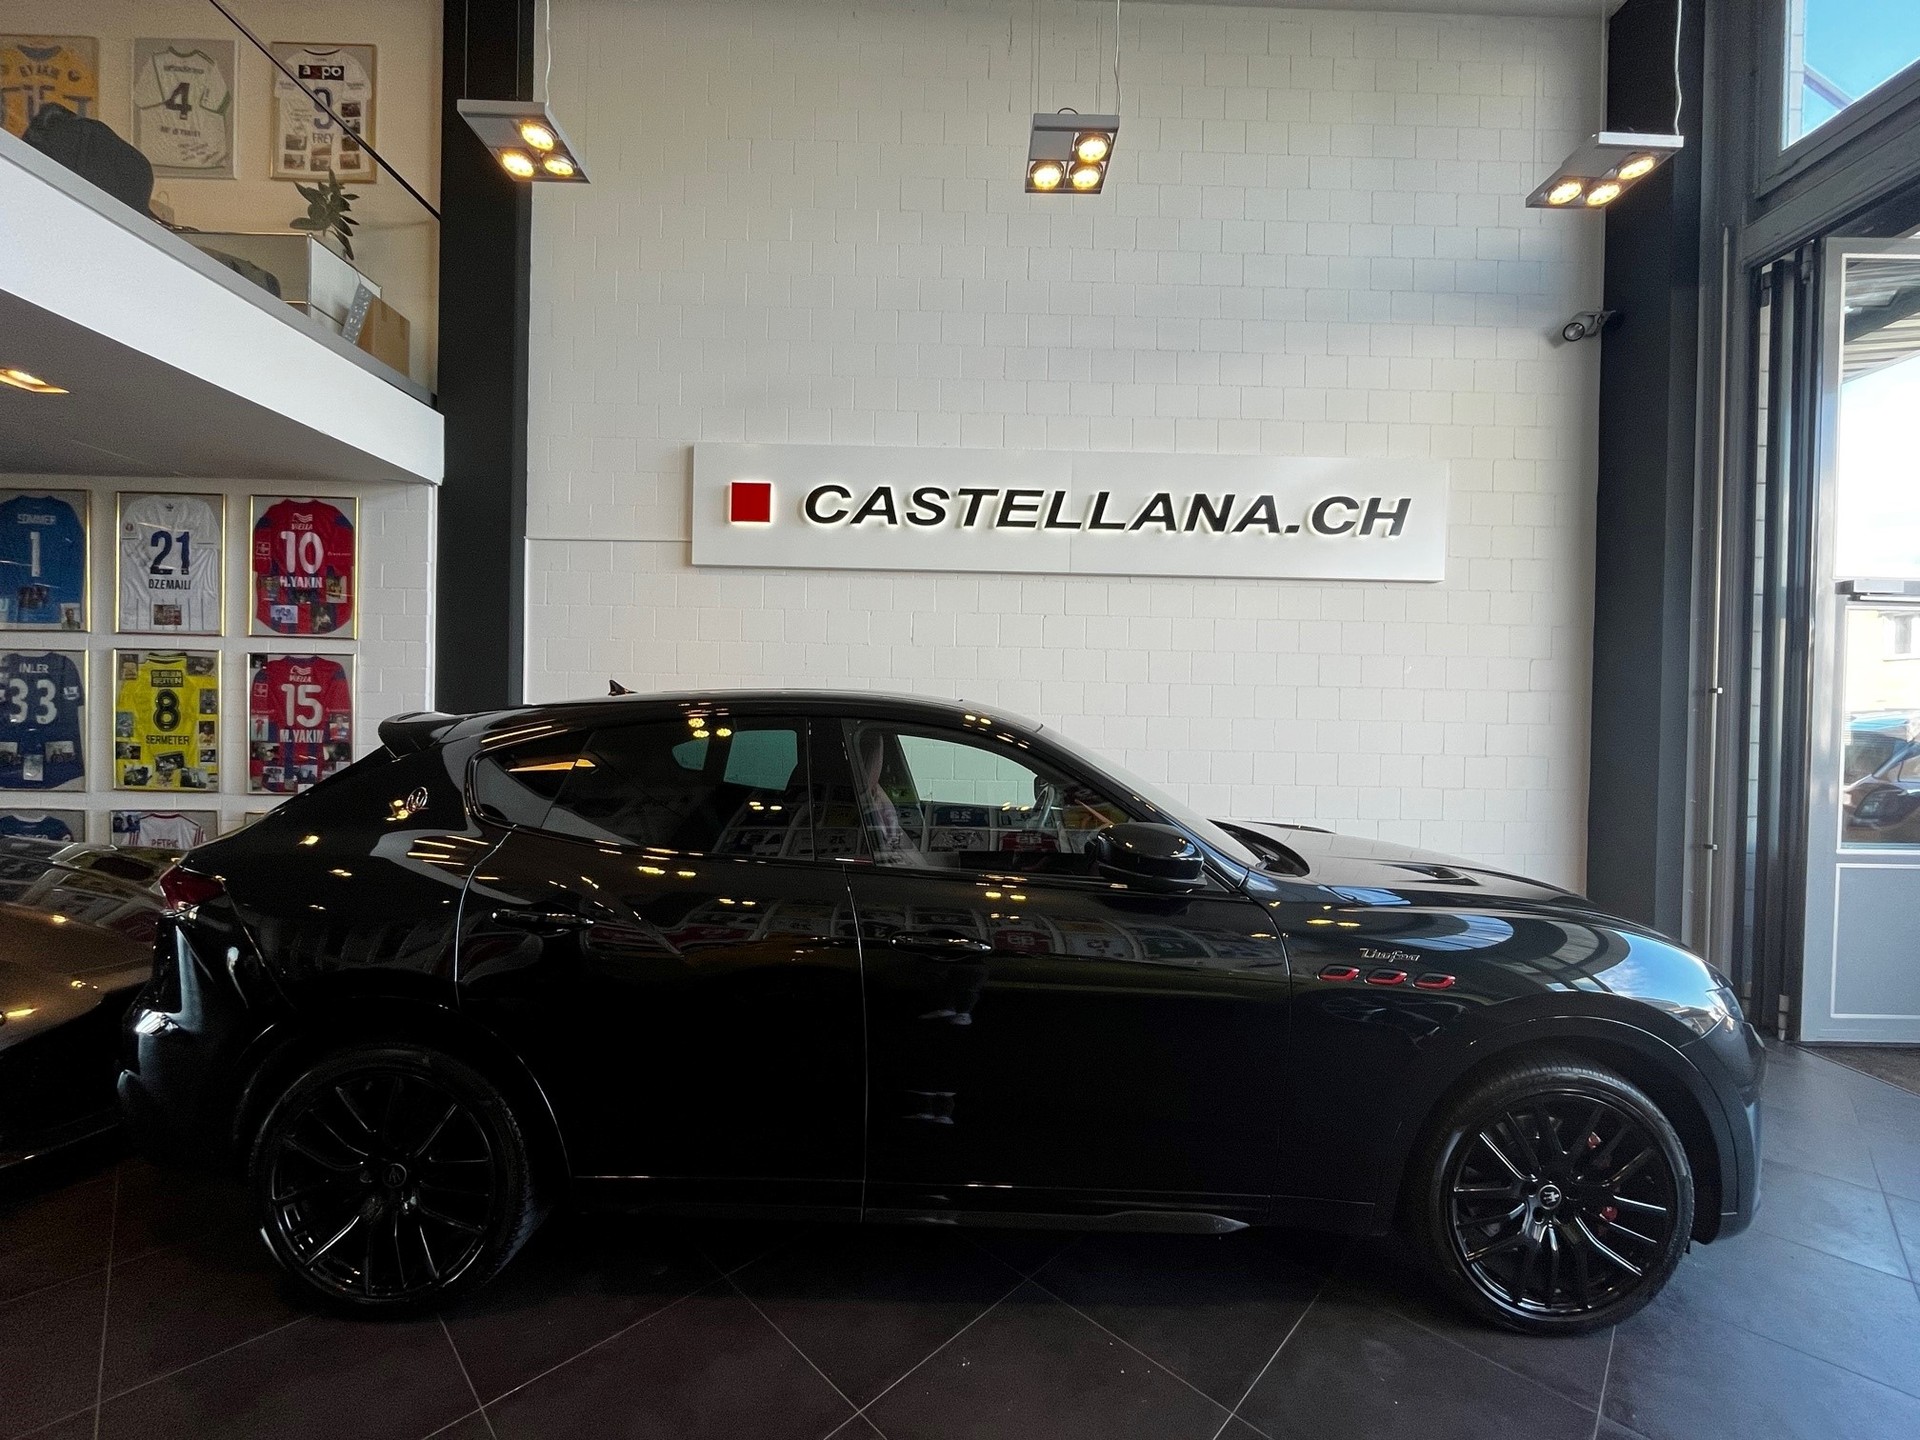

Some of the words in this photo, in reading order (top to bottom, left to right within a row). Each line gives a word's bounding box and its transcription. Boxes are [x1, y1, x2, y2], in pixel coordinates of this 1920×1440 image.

[164, 82, 192, 120] 4
[312, 133, 334, 143] FREY
[17, 513, 56, 525] SOMMER
[803, 483, 1412, 537] CASTELLANA.CH
[30, 531, 41, 577] 1
[150, 531, 190, 575] 21
[280, 530, 324, 574] 10
[148, 579, 192, 590] DZEMAILI
[19, 664, 49, 674] INLER
[9, 678, 57, 725] 33
[153, 689, 181, 732] 8
[281, 683, 323, 728] 15
[145, 735, 190, 745] SERMETER
